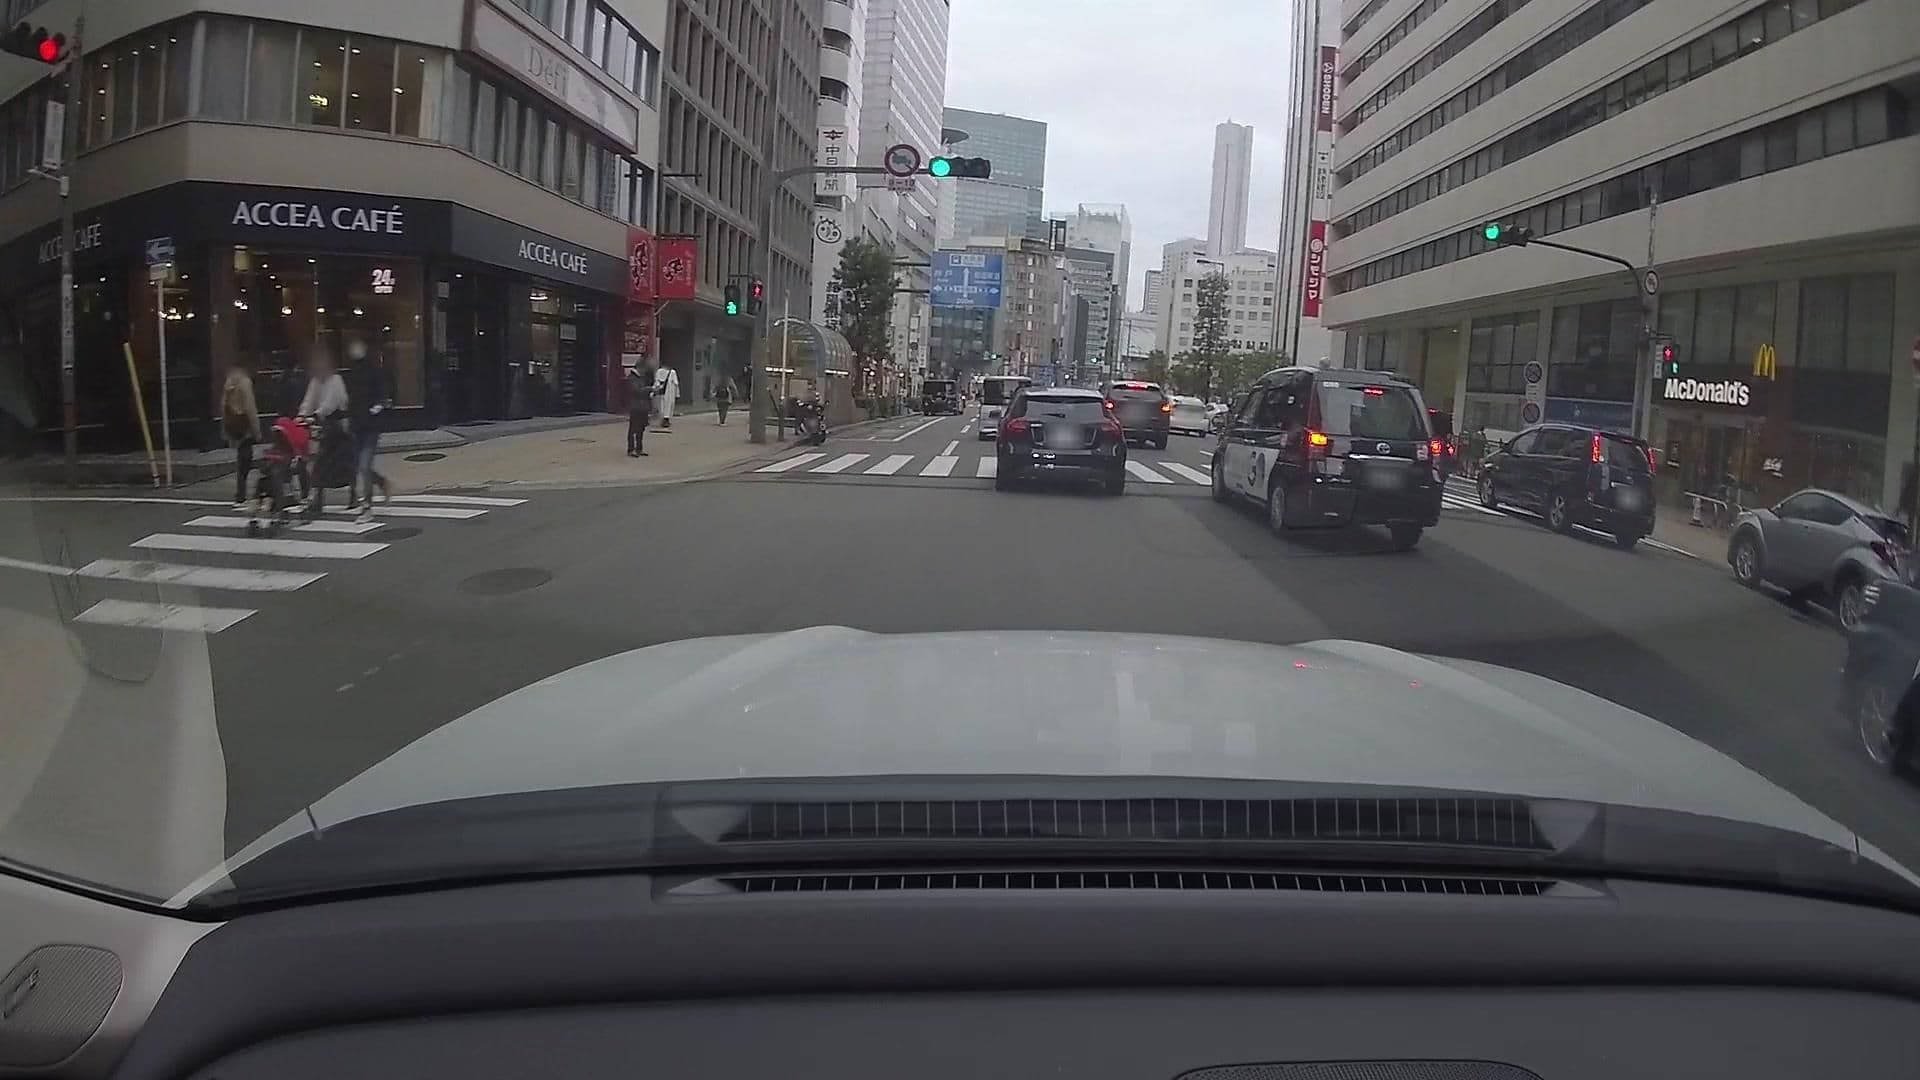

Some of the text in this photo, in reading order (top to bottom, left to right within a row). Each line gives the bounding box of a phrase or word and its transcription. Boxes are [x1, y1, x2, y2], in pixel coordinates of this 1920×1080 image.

[232, 201, 403, 234] ACCEA CAFÉ
[519, 239, 588, 275] ACCEA CAFÉ
[1663, 378, 1750, 406] McDonald's
